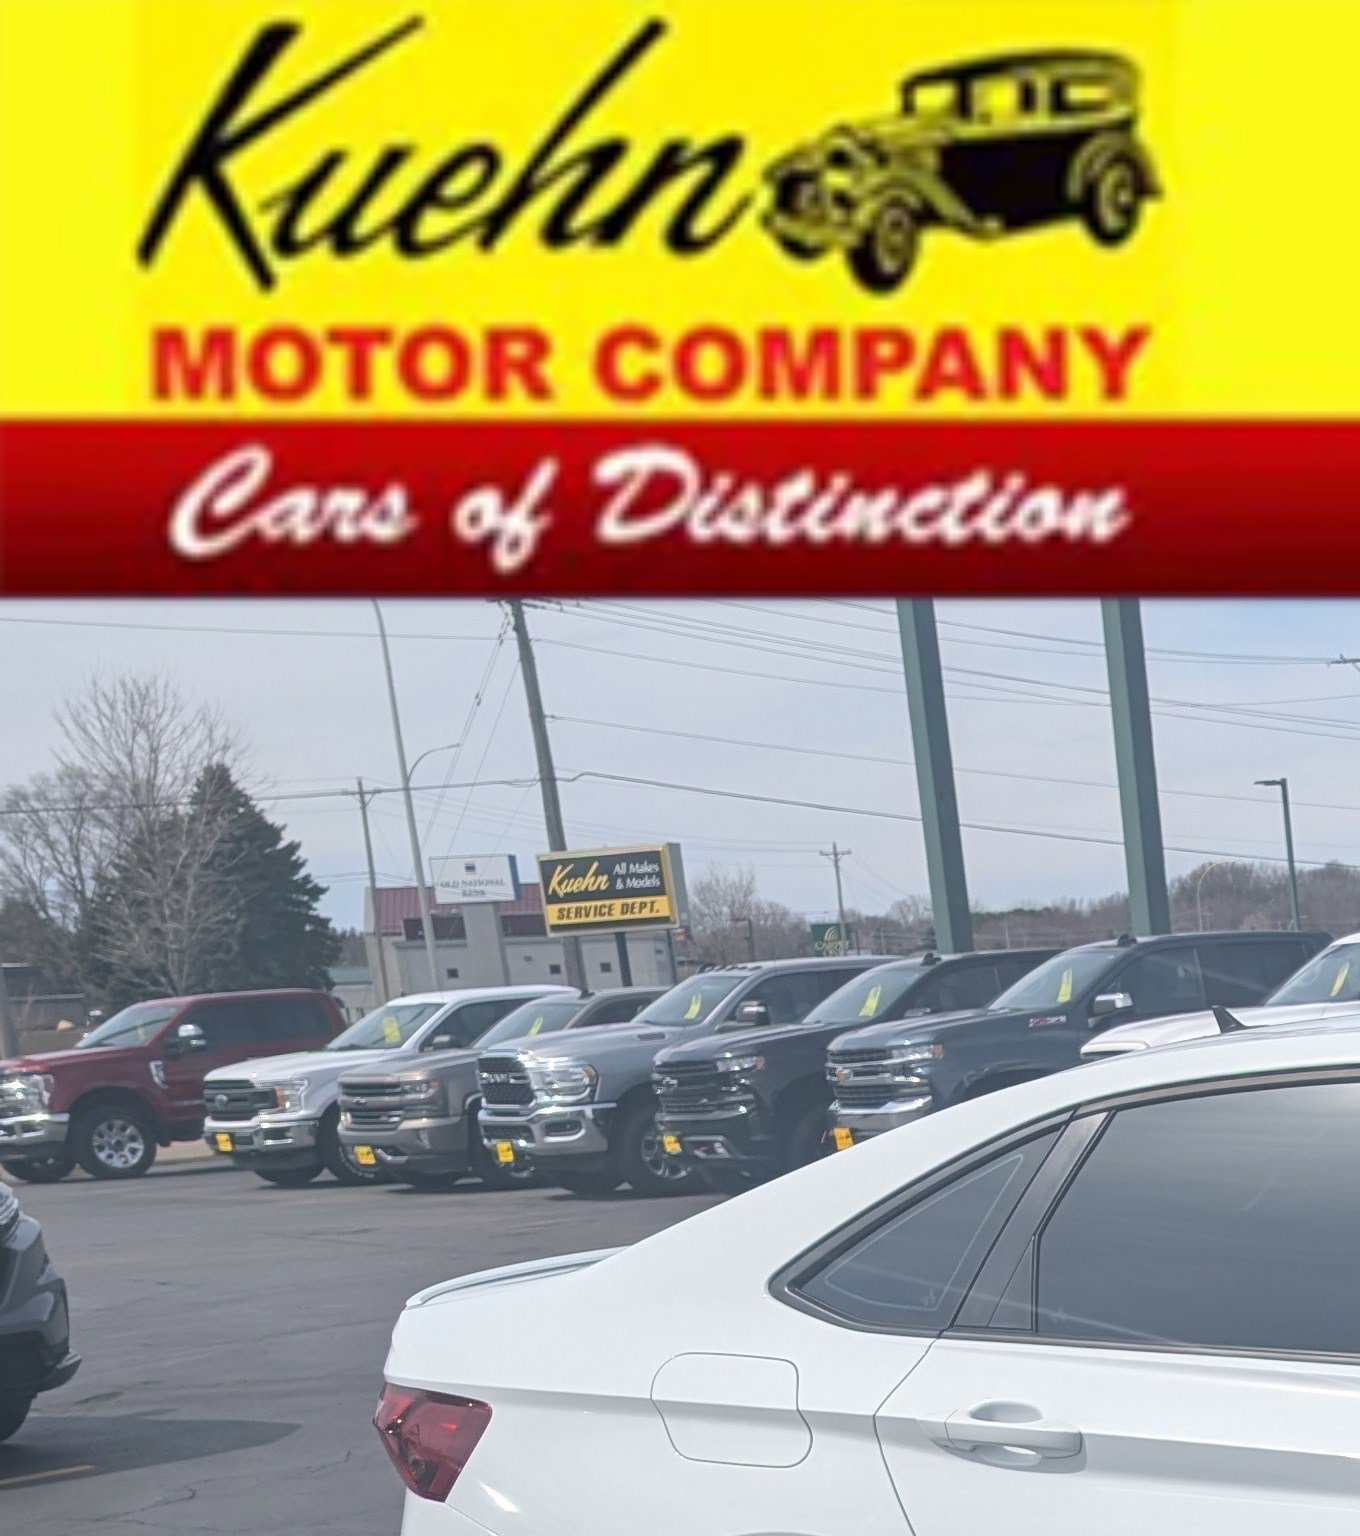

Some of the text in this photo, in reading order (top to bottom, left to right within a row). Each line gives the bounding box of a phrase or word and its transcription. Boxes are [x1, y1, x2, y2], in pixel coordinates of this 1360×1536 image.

[548, 860, 659, 898] Kuehn All Makes
[615, 874, 660, 890] & Models
[557, 900, 660, 920] SERVICE DEPT.
